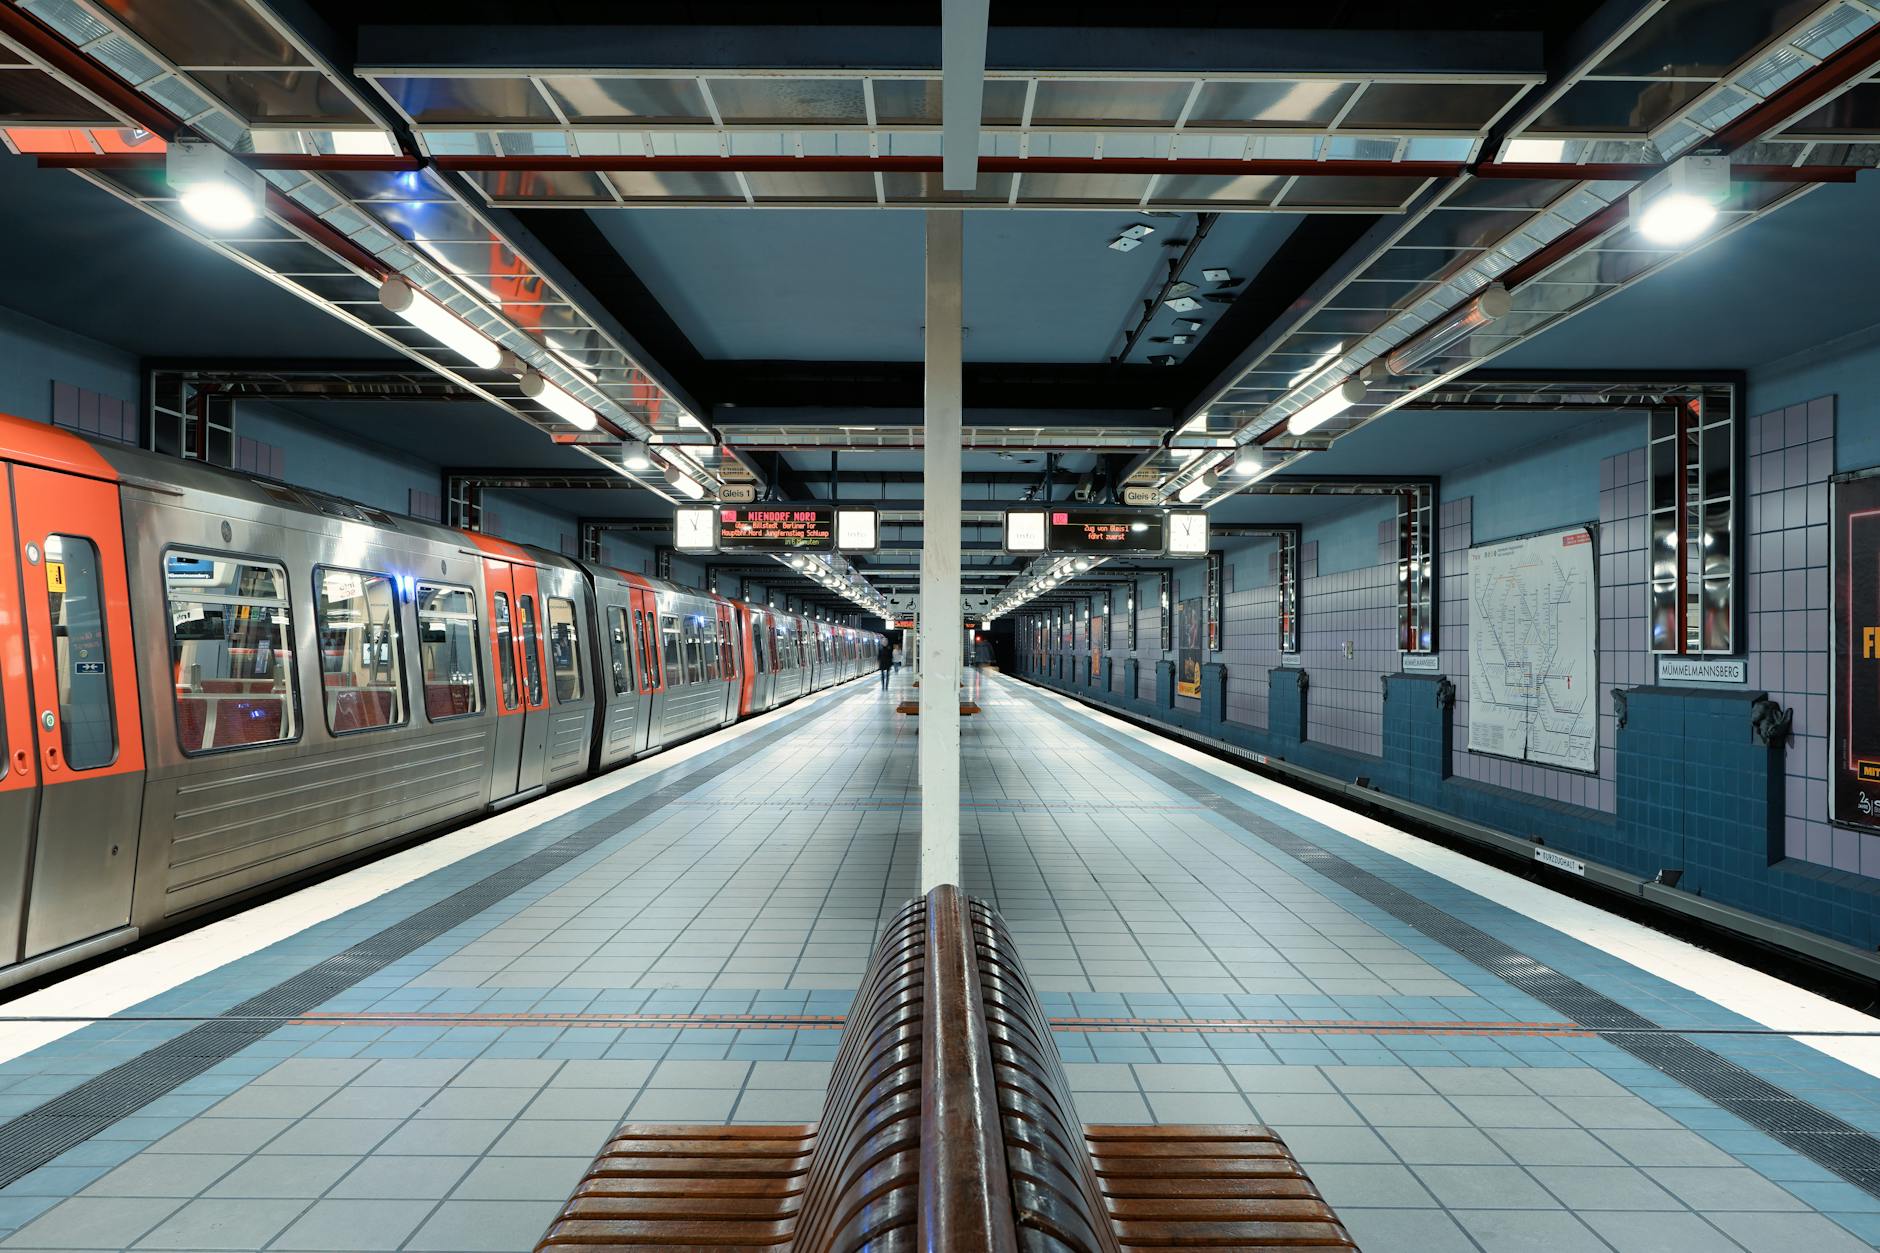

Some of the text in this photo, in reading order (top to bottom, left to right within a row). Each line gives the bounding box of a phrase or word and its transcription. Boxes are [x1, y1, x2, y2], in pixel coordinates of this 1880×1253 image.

[722, 489, 750, 498] Gleis 1
[1128, 491, 1157, 500] Gleis 2
[748, 511, 816, 522] NIENDORF NORD
[807, 529, 830, 538] Schlump
[1084, 524, 1096, 534] Zug
[1661, 662, 1739, 678] MÜMMELMANNSBERG
